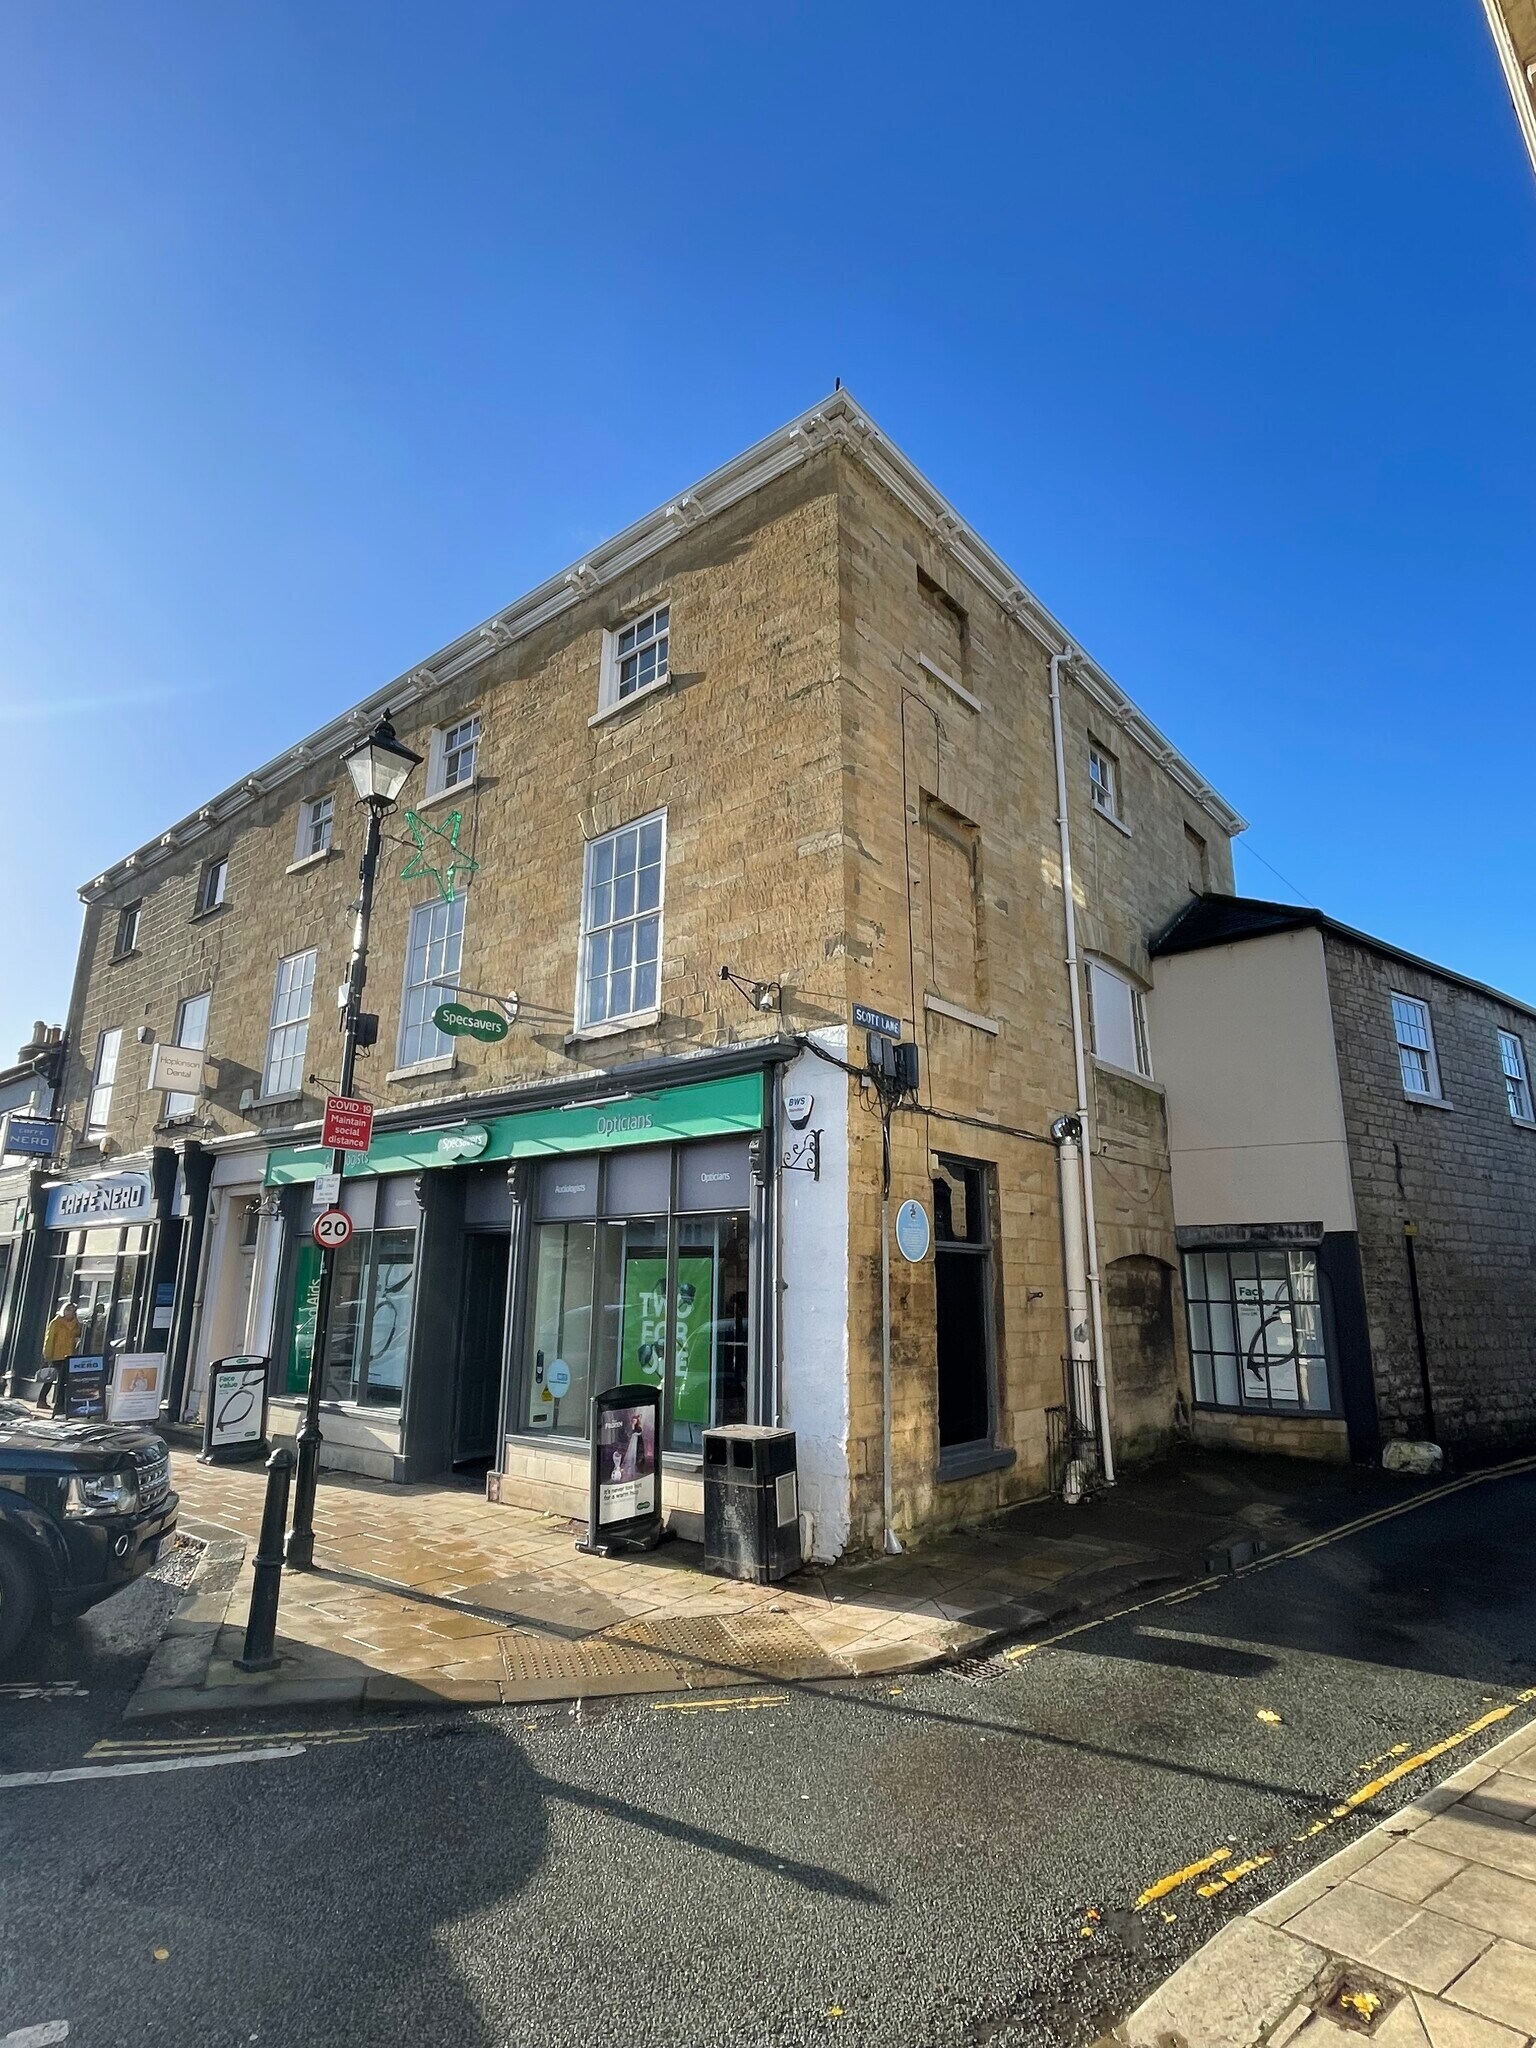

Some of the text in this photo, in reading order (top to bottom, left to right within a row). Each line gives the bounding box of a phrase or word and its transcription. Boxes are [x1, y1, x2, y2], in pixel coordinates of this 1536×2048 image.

[442, 1010, 502, 1033] Specsavers
[856, 1008, 899, 1034] SCOTT LANE
[160, 1056, 200, 1069] Hopkinson
[166, 1068, 192, 1079] Dental
[788, 1097, 806, 1107] BWS
[330, 1114, 367, 1128] Maintain
[597, 1113, 653, 1137] Opticians
[335, 1126, 360, 1137] social
[10, 1136, 50, 1146] NERO
[328, 1136, 364, 1148] distance
[701, 1171, 731, 1184] Opticians
[555, 1184, 586, 1194] Audiologists
[101, 1185, 144, 1211] NERO
[320, 1220, 347, 1237] 20
[307, 1278, 320, 1306] Aids
[219, 1375, 236, 1383] Face
